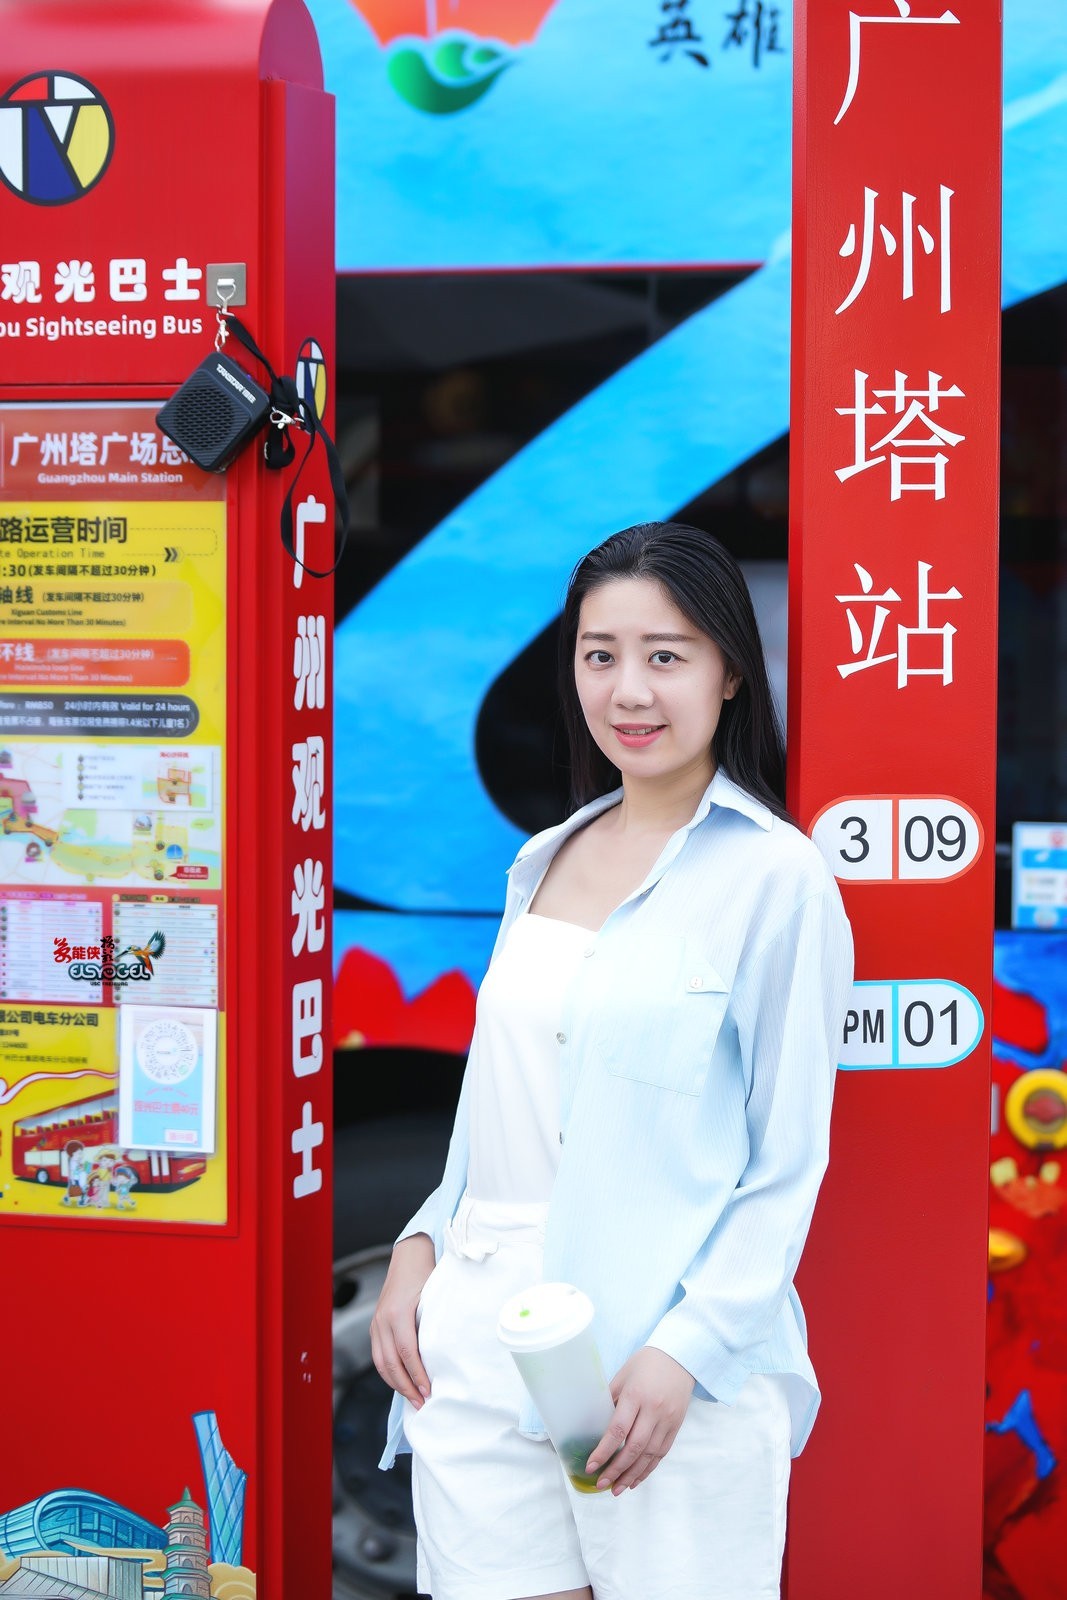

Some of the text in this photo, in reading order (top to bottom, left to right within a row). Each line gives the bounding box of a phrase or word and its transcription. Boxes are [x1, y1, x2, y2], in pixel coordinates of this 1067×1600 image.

[1, 257, 203, 304] 观光巴士
[26, 314, 157, 341] Sightseeing
[163, 315, 203, 335] Bus
[833, 0, 967, 690] 广州塔站
[37, 472, 183, 486] Guangzhou Main Station
[0, 516, 128, 544] 路运营时间
[16, 548, 74, 559] Operation
[80, 547, 105, 558] Time
[291, 494, 327, 1200] 广州观光巴士
[839, 815, 966, 863] 3 09
[843, 1000, 957, 1047] PM 01
